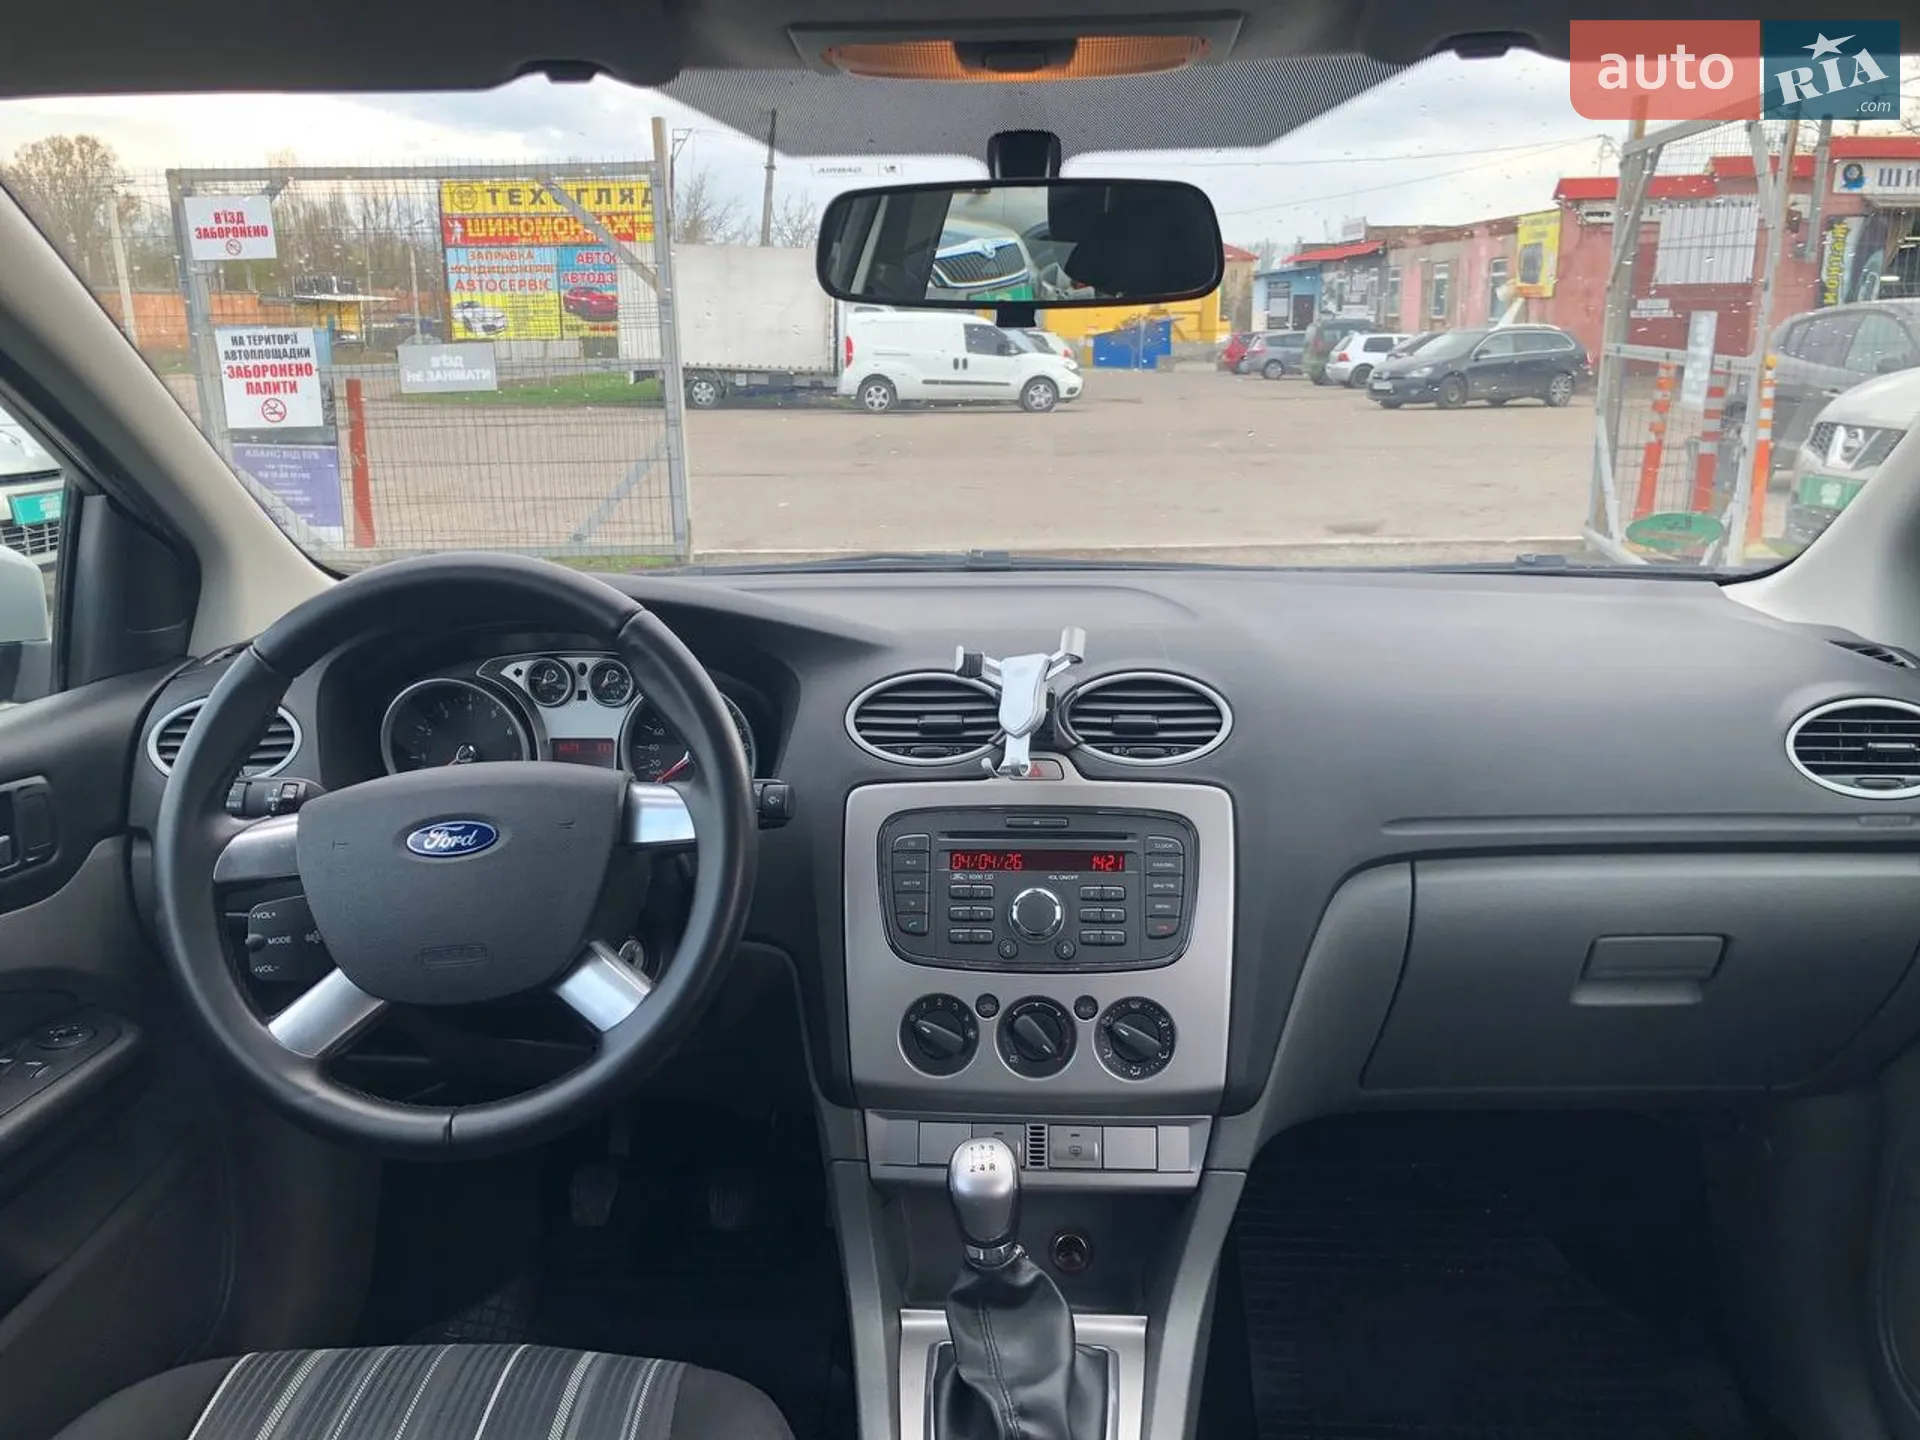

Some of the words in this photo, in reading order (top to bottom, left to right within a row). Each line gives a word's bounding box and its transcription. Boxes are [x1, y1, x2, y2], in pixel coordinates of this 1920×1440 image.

[195, 225, 269, 240] ЗАБОРОНЕНО
[454, 278, 553, 292] АВТОСЕРВІС
[230, 335, 246, 347] НА
[247, 332, 299, 346] ТЕРИТОРІЇ
[224, 347, 312, 361] АВТОПЛОЩАДКИ
[226, 362, 314, 379] ЗАБОРОНЕНО
[245, 380, 299, 396] ПАЛИТИ
[424, 825, 478, 850] Ford
[952, 853, 1022, 871] 04/04/26
